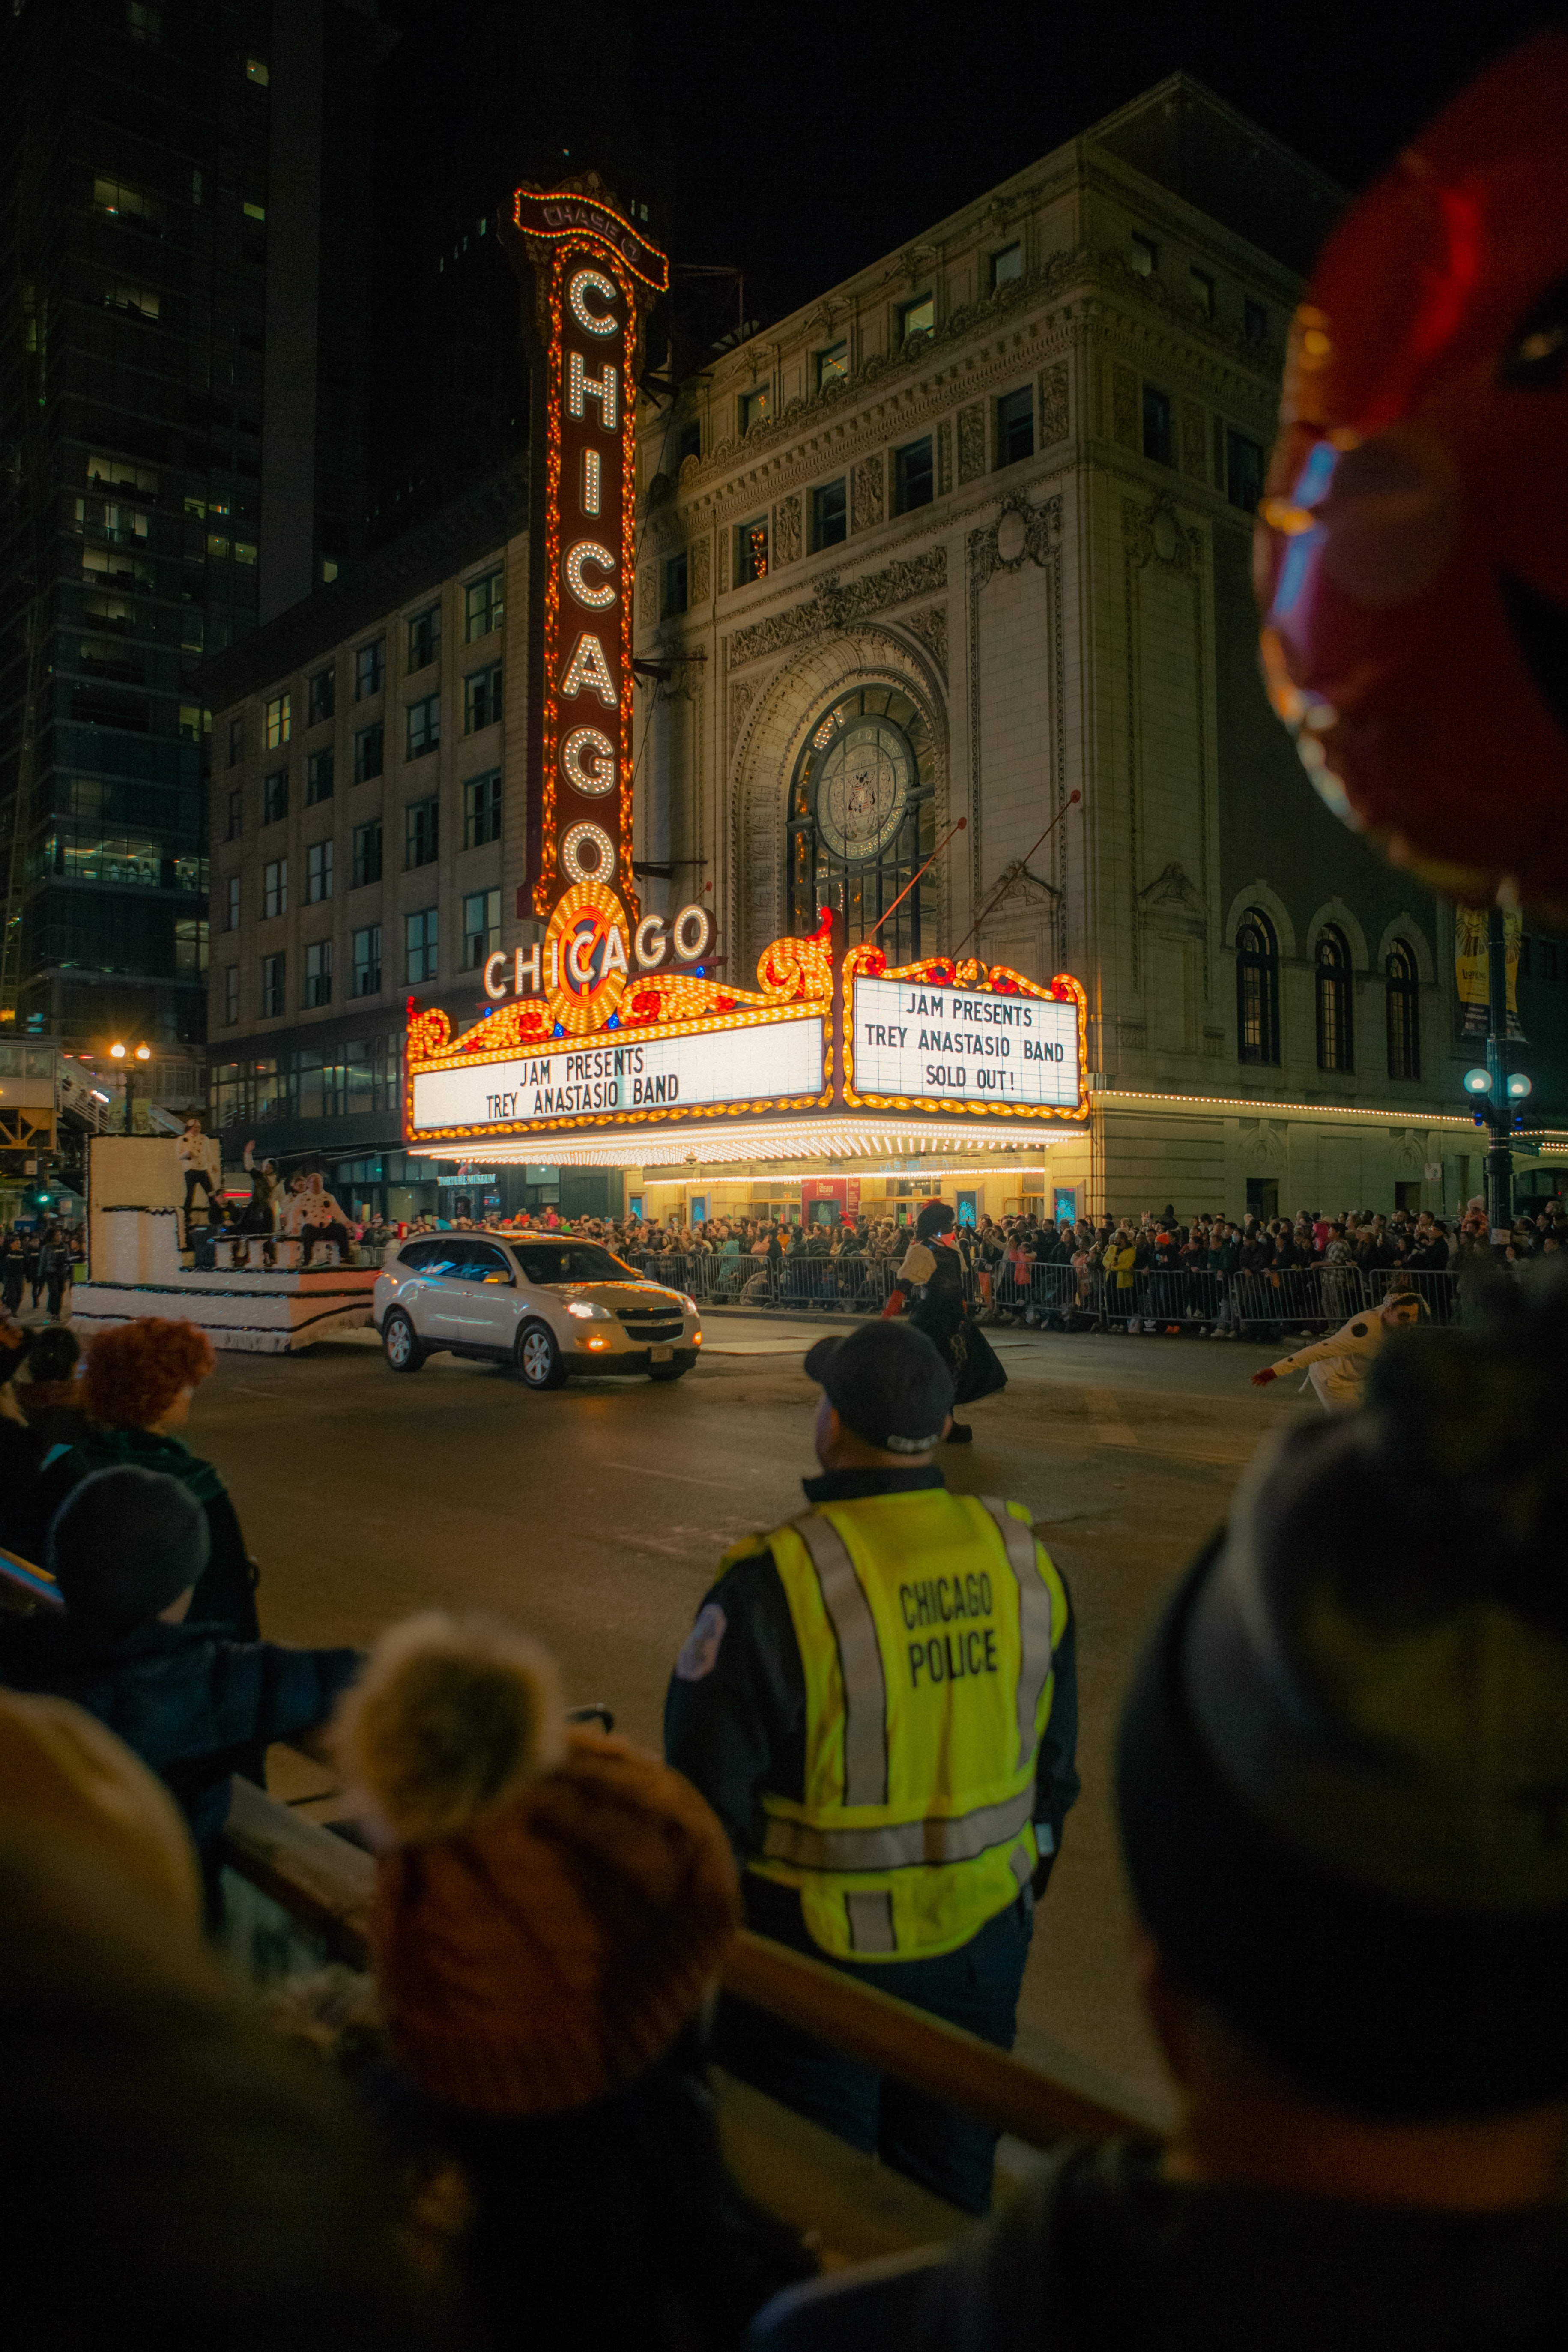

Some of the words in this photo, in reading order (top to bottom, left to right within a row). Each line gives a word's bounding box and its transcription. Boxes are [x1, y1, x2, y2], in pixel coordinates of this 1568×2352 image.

[543, 206, 619, 242] CHASE
[562, 269, 618, 883] CHICAGO
[484, 904, 709, 1000] CHICAGO
[906, 993, 943, 1018] JAM
[953, 998, 1032, 1027] PRESENTS
[865, 1024, 908, 1048] TREY
[917, 1029, 1010, 1057] ANASTASIO
[1024, 1040, 1063, 1063] BAND
[520, 1059, 551, 1087] JAM
[567, 1047, 644, 1082] PRESENTS
[926, 1065, 966, 1088] SOLD
[977, 1069, 1015, 1091] OUT!
[486, 1092, 518, 1119] TREY
[534, 1080, 618, 1115] ANASTASIO
[633, 1074, 679, 1105] BAND
[438, 1175, 467, 1186] TORTURE
[467, 1174, 496, 1184] MUSEUM
[900, 1571, 993, 1630] CHICAGO
[908, 1628, 998, 1688] POLICE
